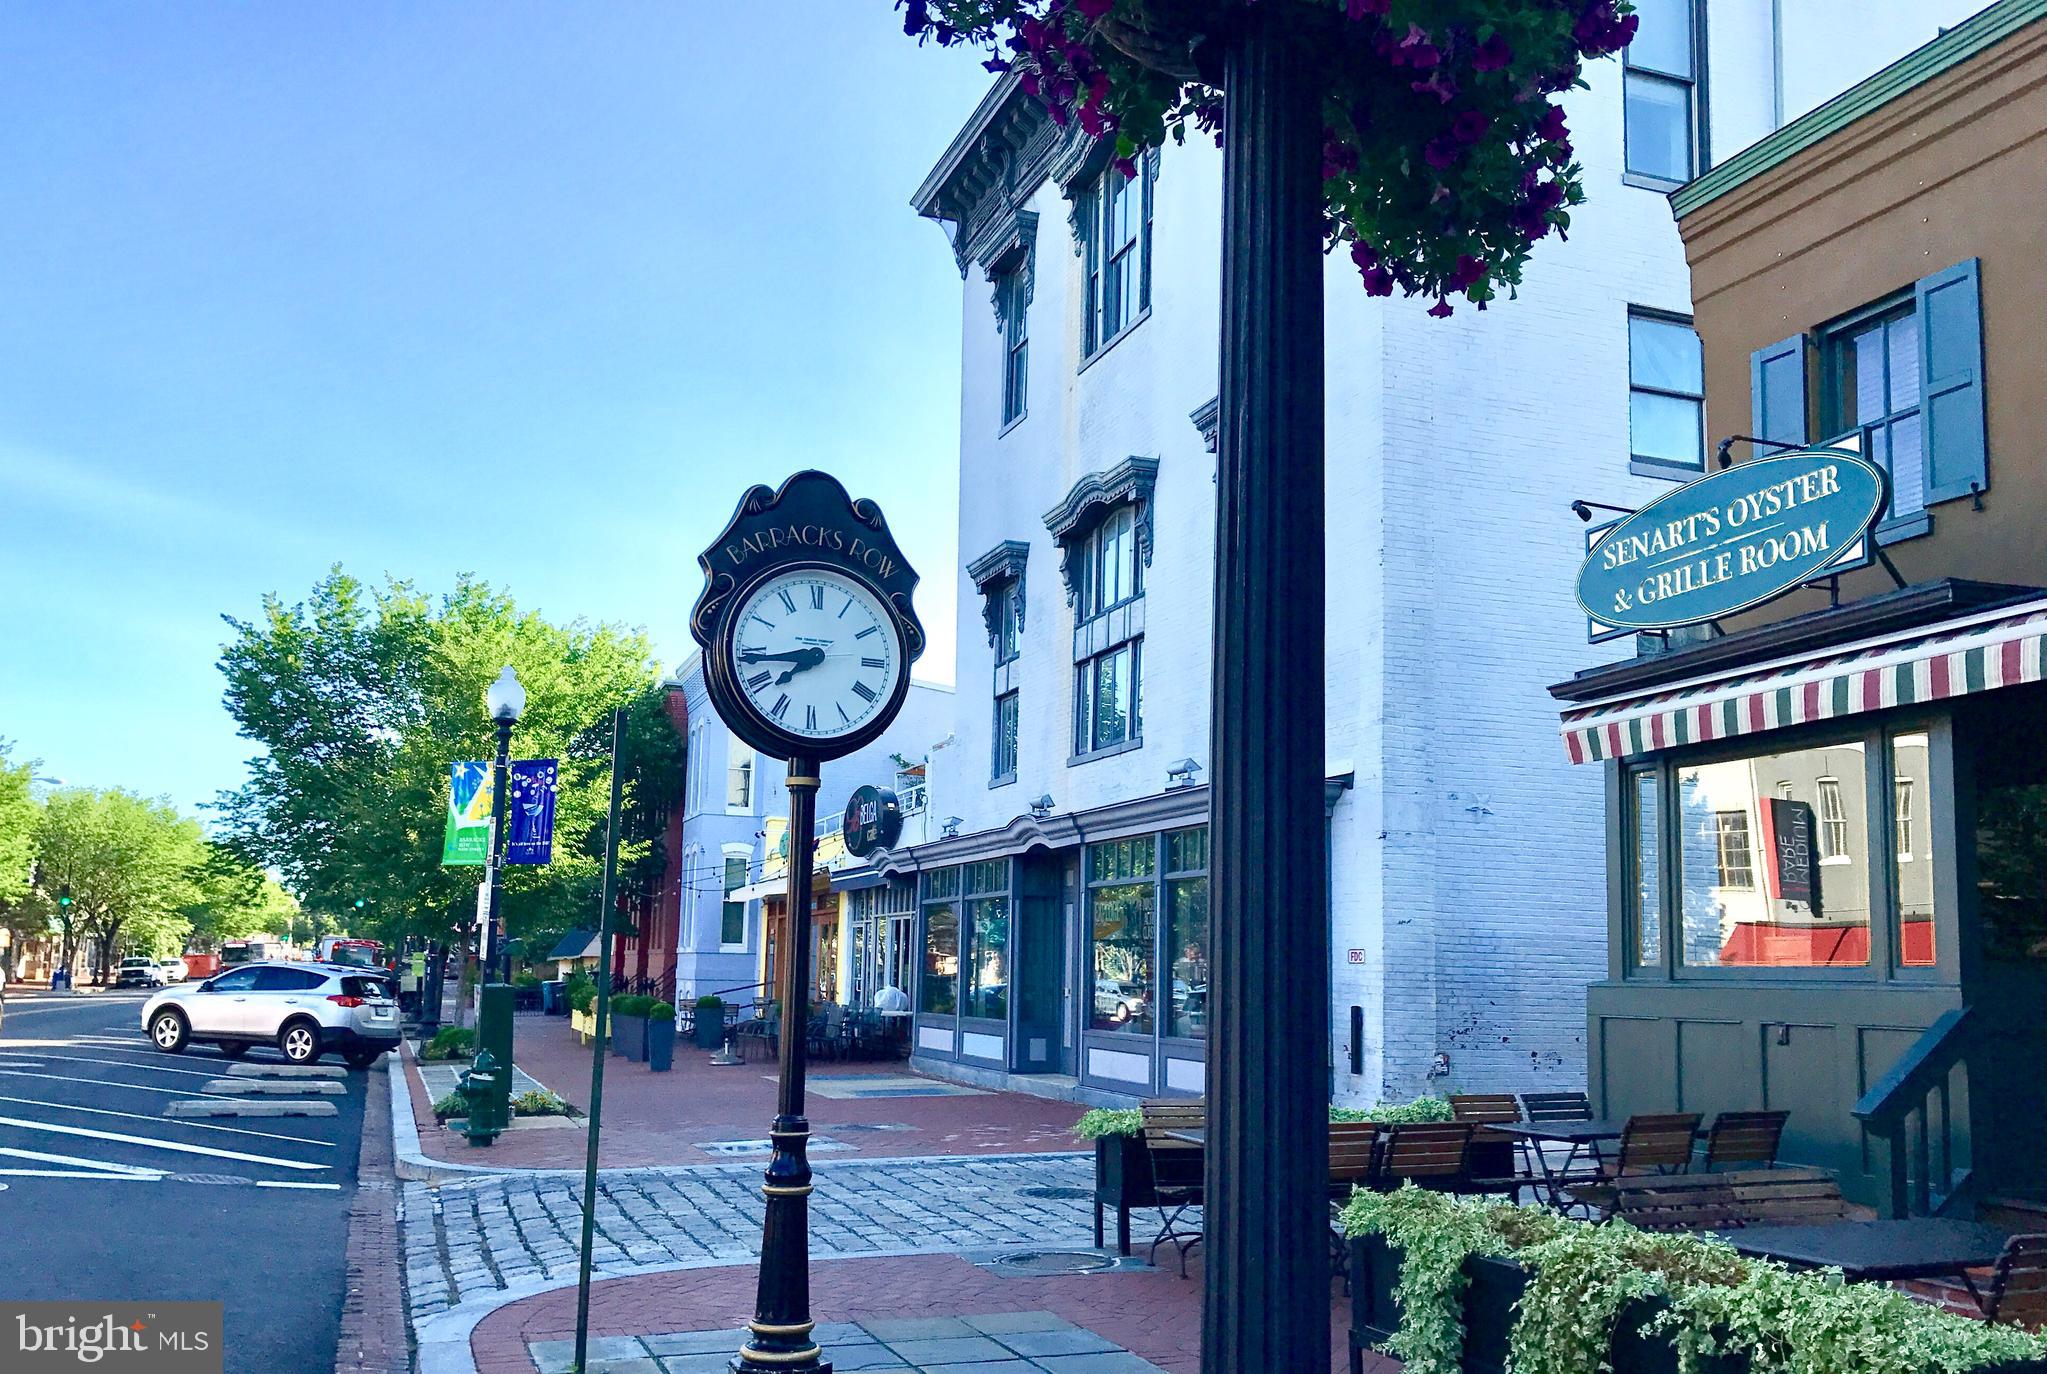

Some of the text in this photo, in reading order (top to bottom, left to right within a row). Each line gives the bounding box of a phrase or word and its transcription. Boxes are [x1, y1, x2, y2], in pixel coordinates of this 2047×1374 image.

[1603, 464, 1841, 571] SENART'S OYSTER
[726, 525, 900, 580] BARRACKS ROW
[1613, 520, 1830, 614] & GRILLE ROOM
[860, 800, 877, 826] BELGA
[1350, 951, 1363, 962] FDC
